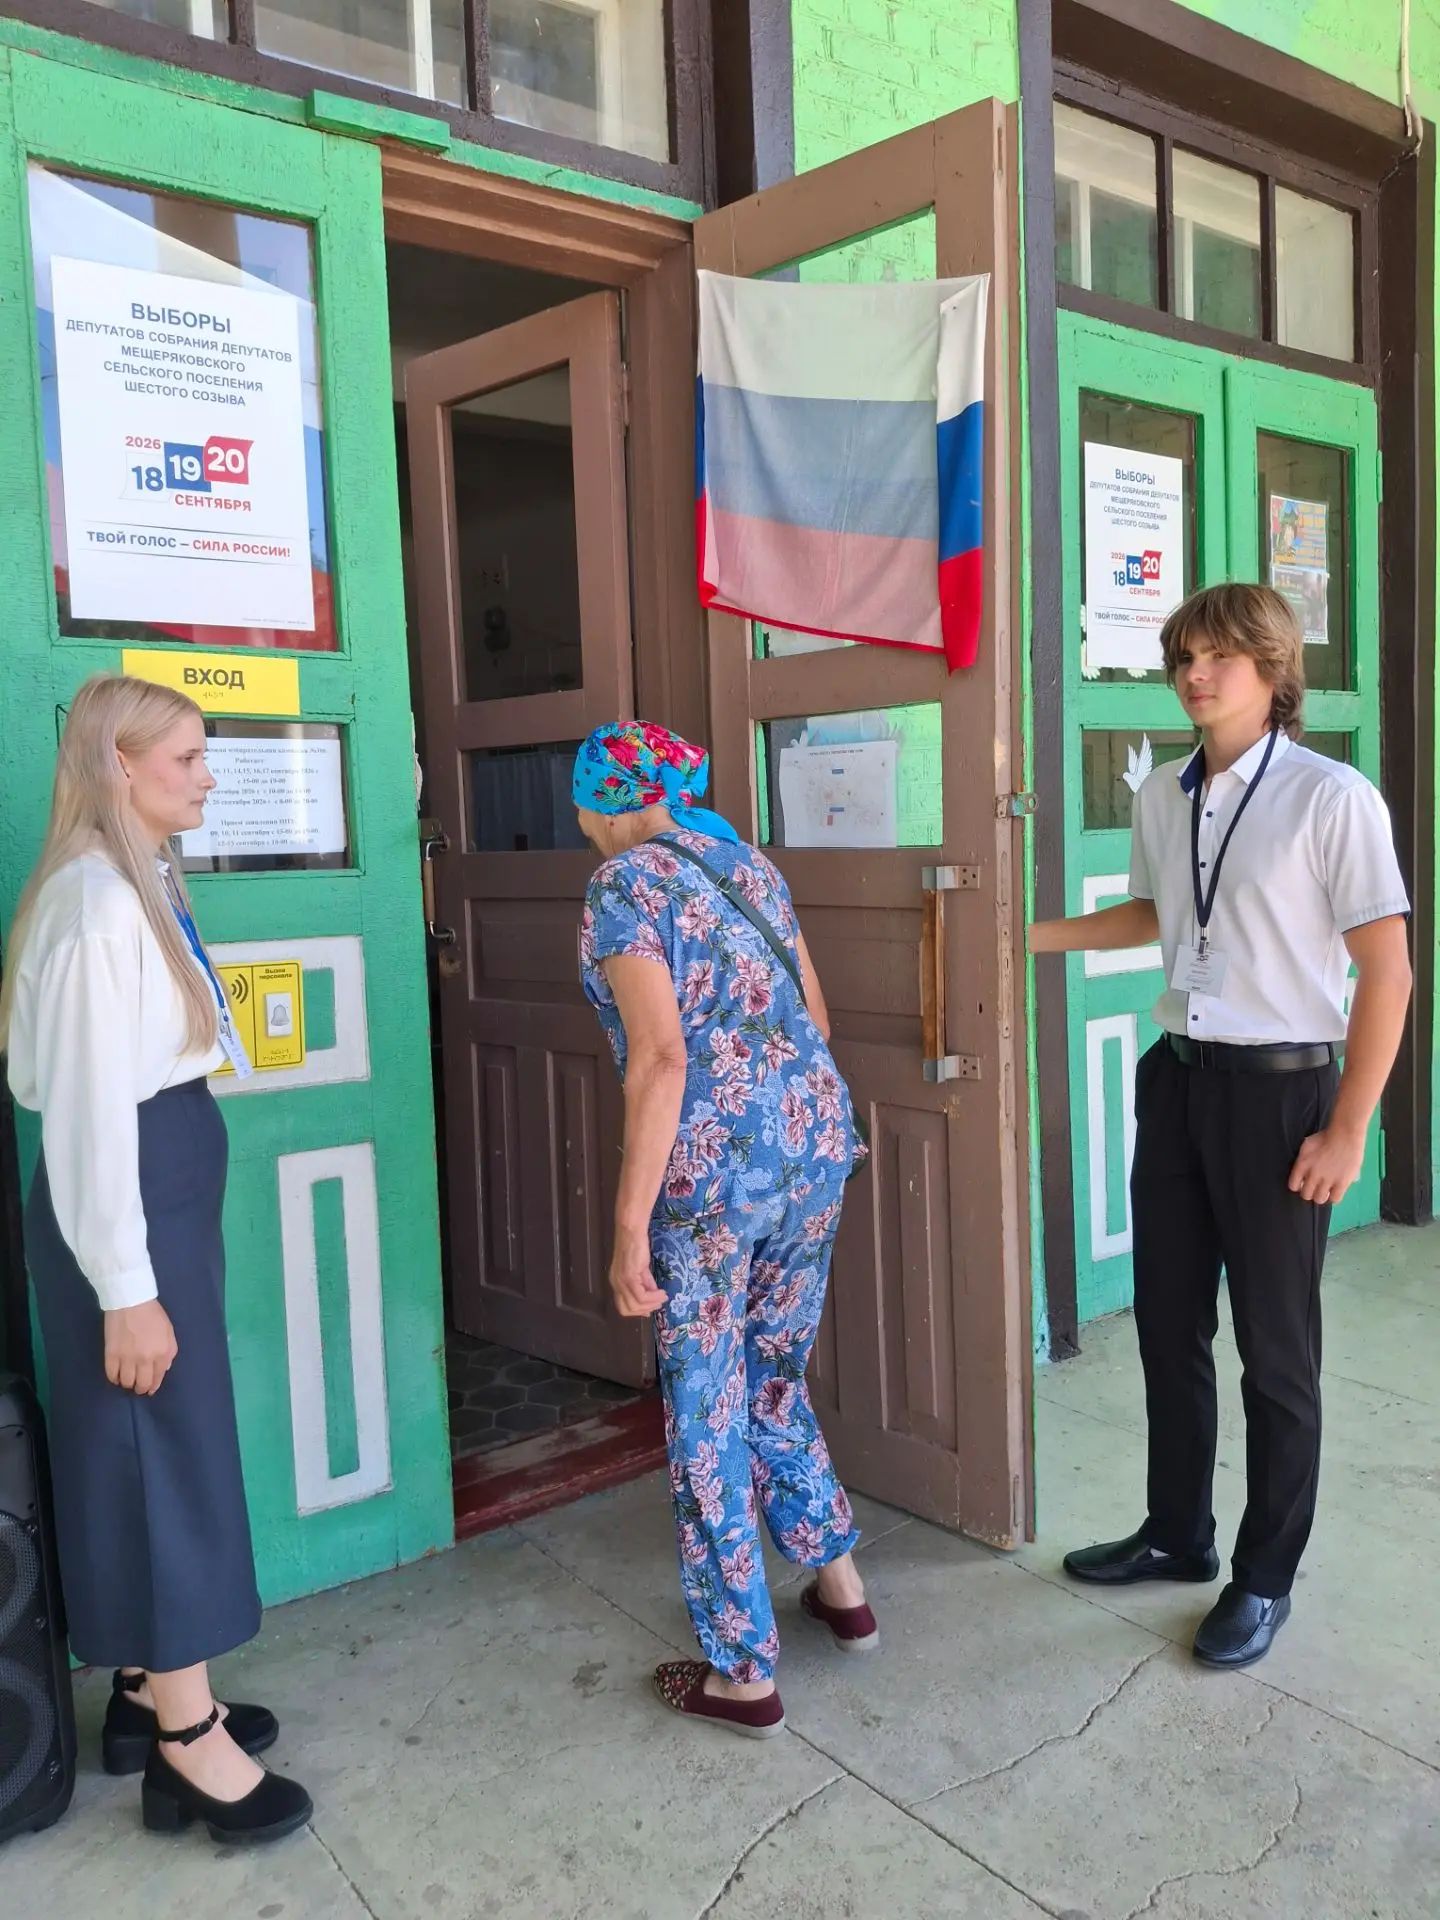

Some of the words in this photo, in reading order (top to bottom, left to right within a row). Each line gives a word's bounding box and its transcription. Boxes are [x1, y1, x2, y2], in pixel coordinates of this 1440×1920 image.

[131, 302, 231, 334] ВЫБОРЫ
[66, 318, 145, 340] ДЕПУТАТОВ
[149, 331, 218, 352] СОБРАНИЯ
[221, 342, 292, 362] ДЕПУТАТОВ
[121, 345, 245, 373] МЕЩЕРЯКОВСКОГО
[103, 361, 183, 381] СЕЛЬСКОГО
[186, 372, 263, 392] ПОСЕЛЕНИЯ
[124, 380, 188, 399] ШЕСТОГО
[191, 390, 246, 407] СОЗЫВА
[125, 435, 161, 450] 2026
[131, 465, 164, 492] 18
[169, 455, 201, 482] 19
[207, 446, 245, 474] 20
[1115, 468, 1155, 485] ВЫБОРЫ
[1090, 481, 1121, 492] ДЕПУТАТОВ
[1121, 486, 1150, 496] СОБРАНИЯ
[175, 494, 251, 512] СЕНТЯБРЯ
[1104, 505, 1135, 517] СЕЛЬСКОГО
[1136, 511, 1167, 520] ПОСЕЛЕНИЯ
[87, 530, 126, 544] ТВОЙ
[130, 534, 177, 549] ГОЛОС
[193, 539, 229, 552] СИЛА
[233, 543, 291, 557] РОССИИ!
[1111, 552, 1125, 560] 2026
[1113, 570, 1126, 586] 18
[1128, 562, 1141, 579] 19
[1143, 557, 1159, 574] 20
[1129, 587, 1161, 597] СЕНТЯБРЯ
[1095, 611, 1111, 620] ТВОЙ
[1111, 613, 1130, 621] ГОЛОС
[183, 667, 245, 690] ВХОД
